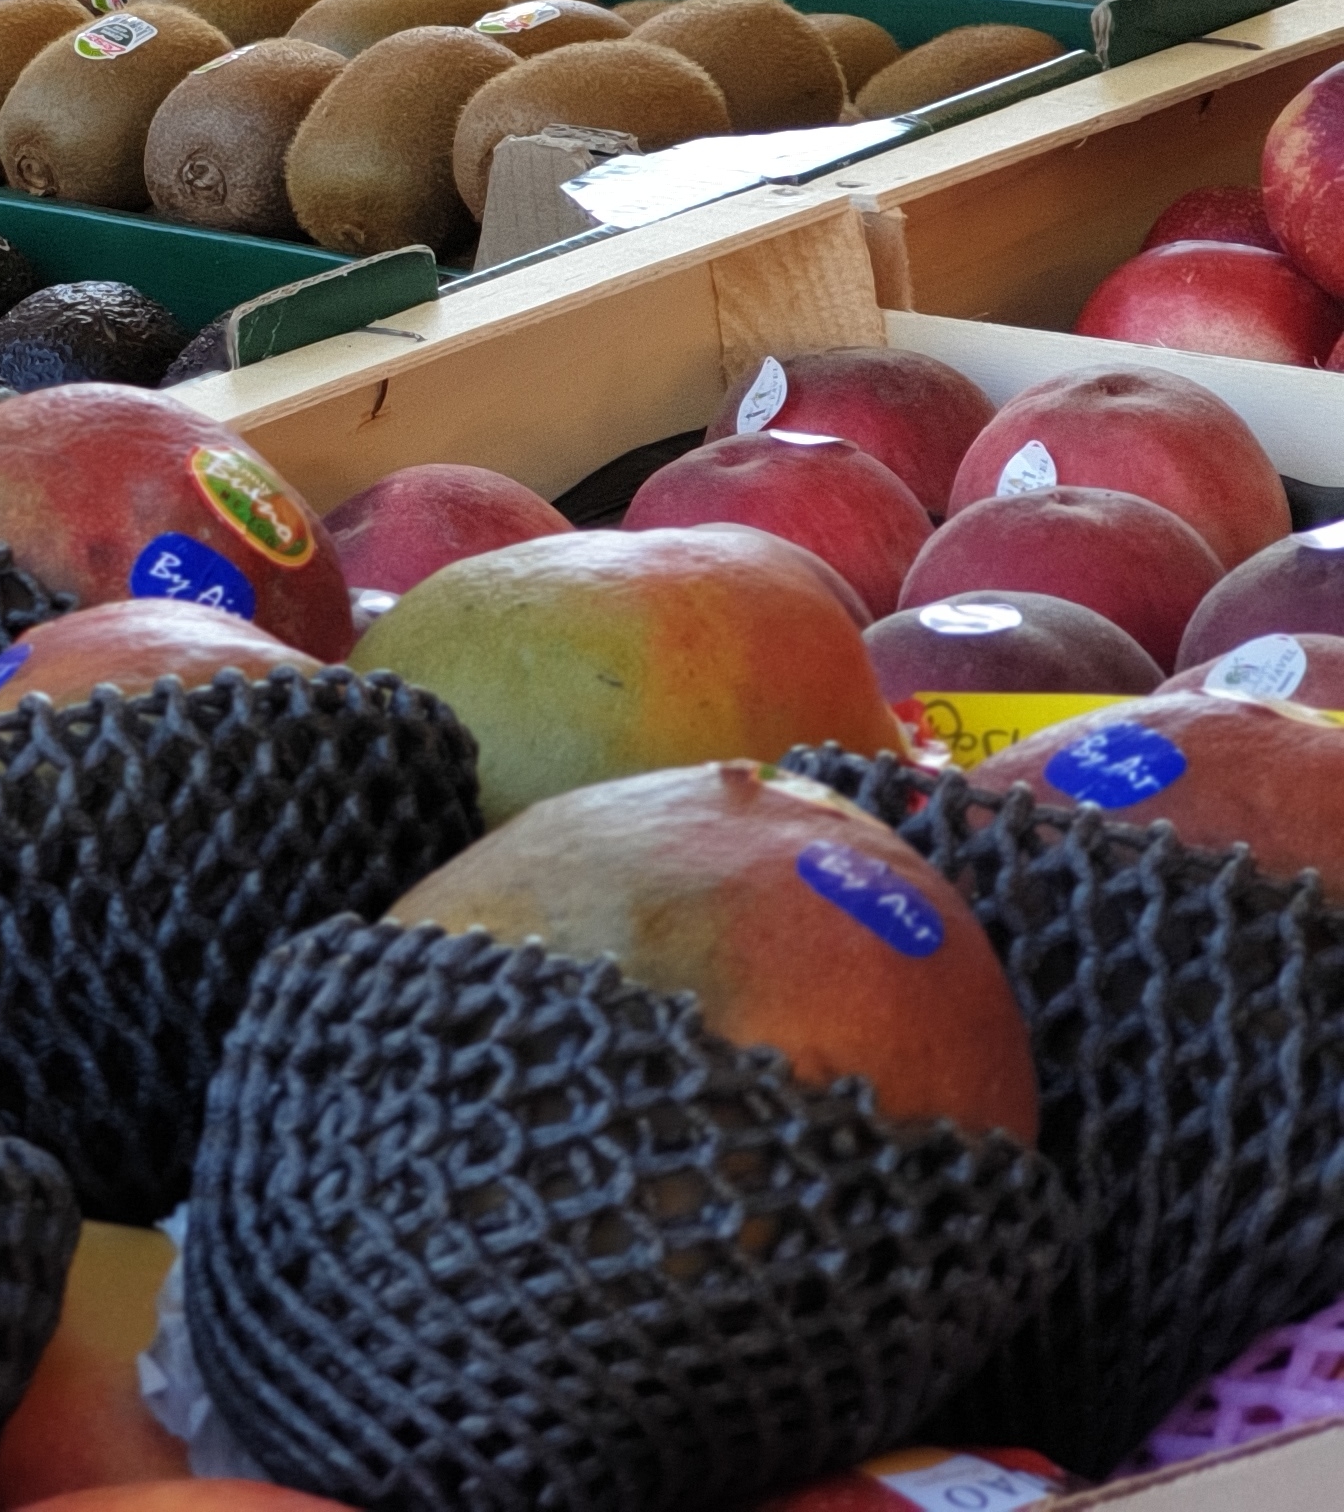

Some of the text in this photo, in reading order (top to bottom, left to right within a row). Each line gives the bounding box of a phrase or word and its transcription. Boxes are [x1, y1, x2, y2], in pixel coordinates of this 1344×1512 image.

[149, 551, 191, 597] By
[1072, 733, 1162, 793] By Air
